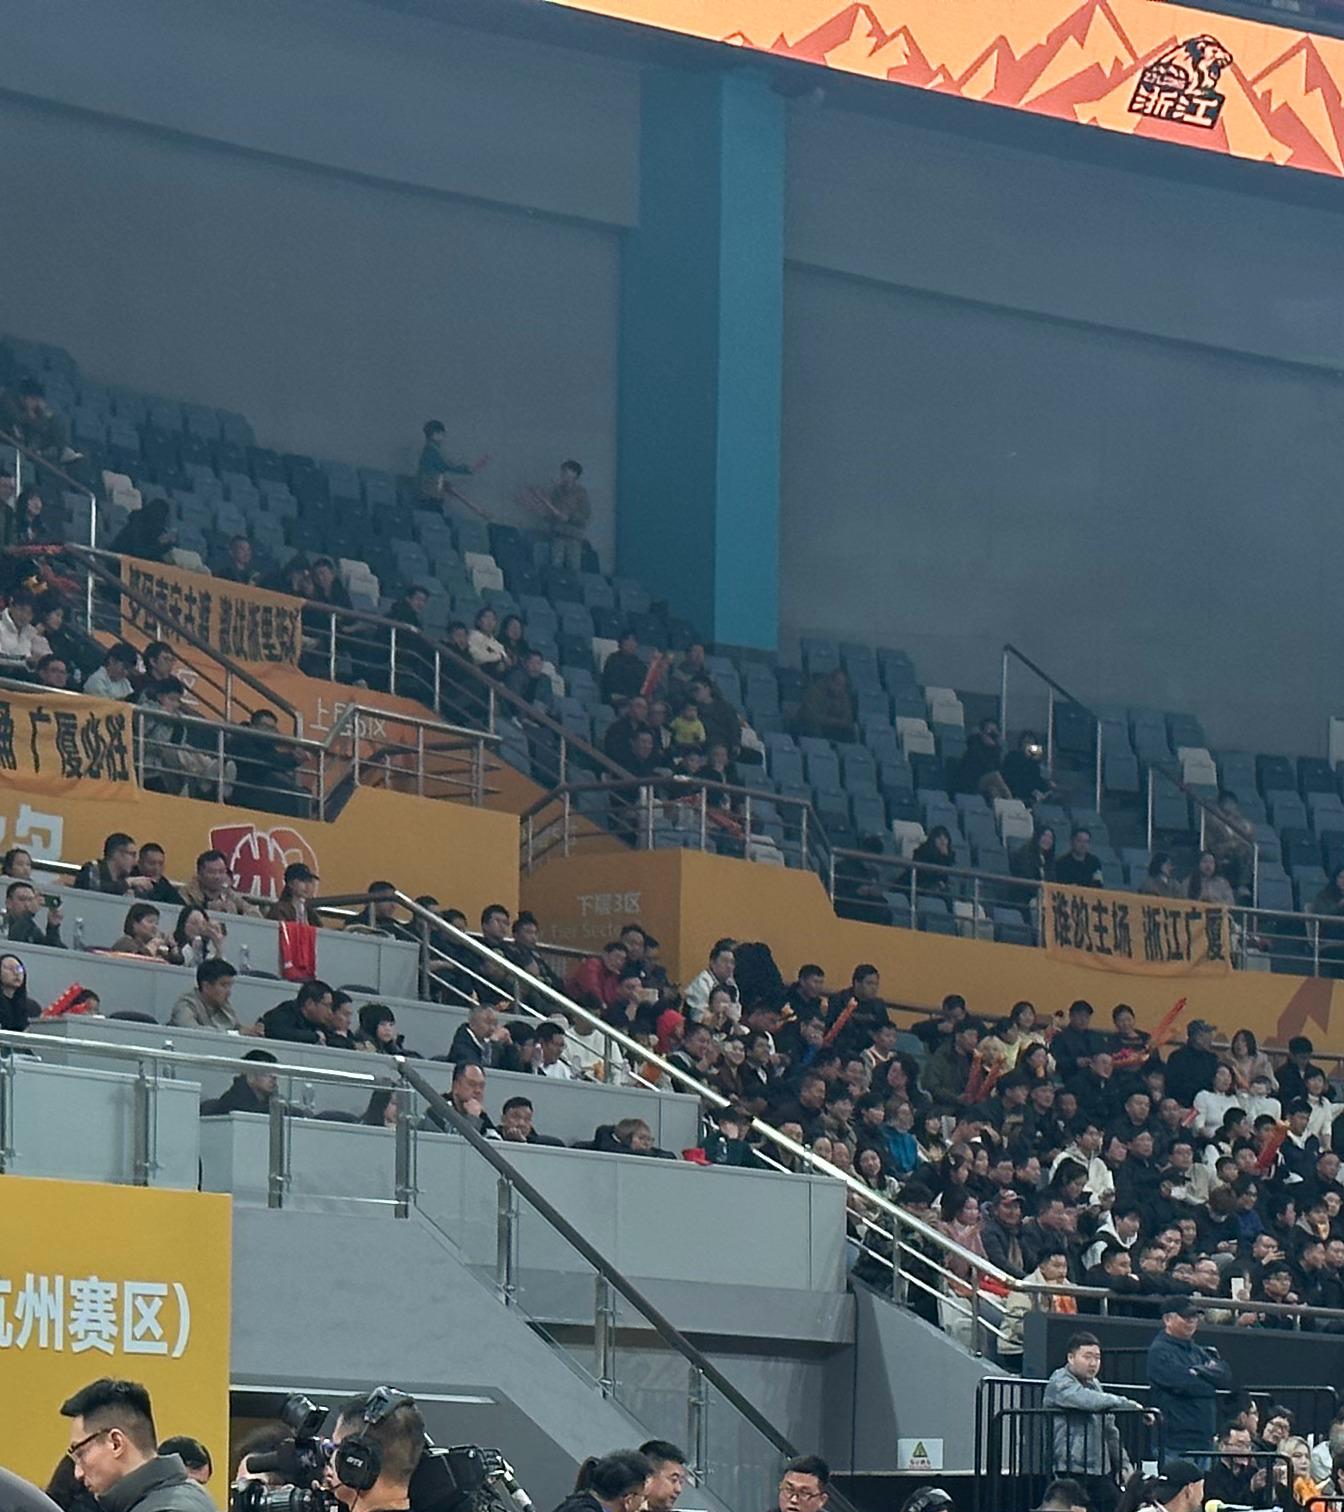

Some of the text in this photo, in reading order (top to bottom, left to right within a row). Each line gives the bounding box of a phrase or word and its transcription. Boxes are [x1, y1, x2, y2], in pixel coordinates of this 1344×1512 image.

[1131, 86, 1218, 126] 浙江
[29, 706, 130, 782] 广厦必胜
[1142, 905, 1225, 961] 浙江广厦
